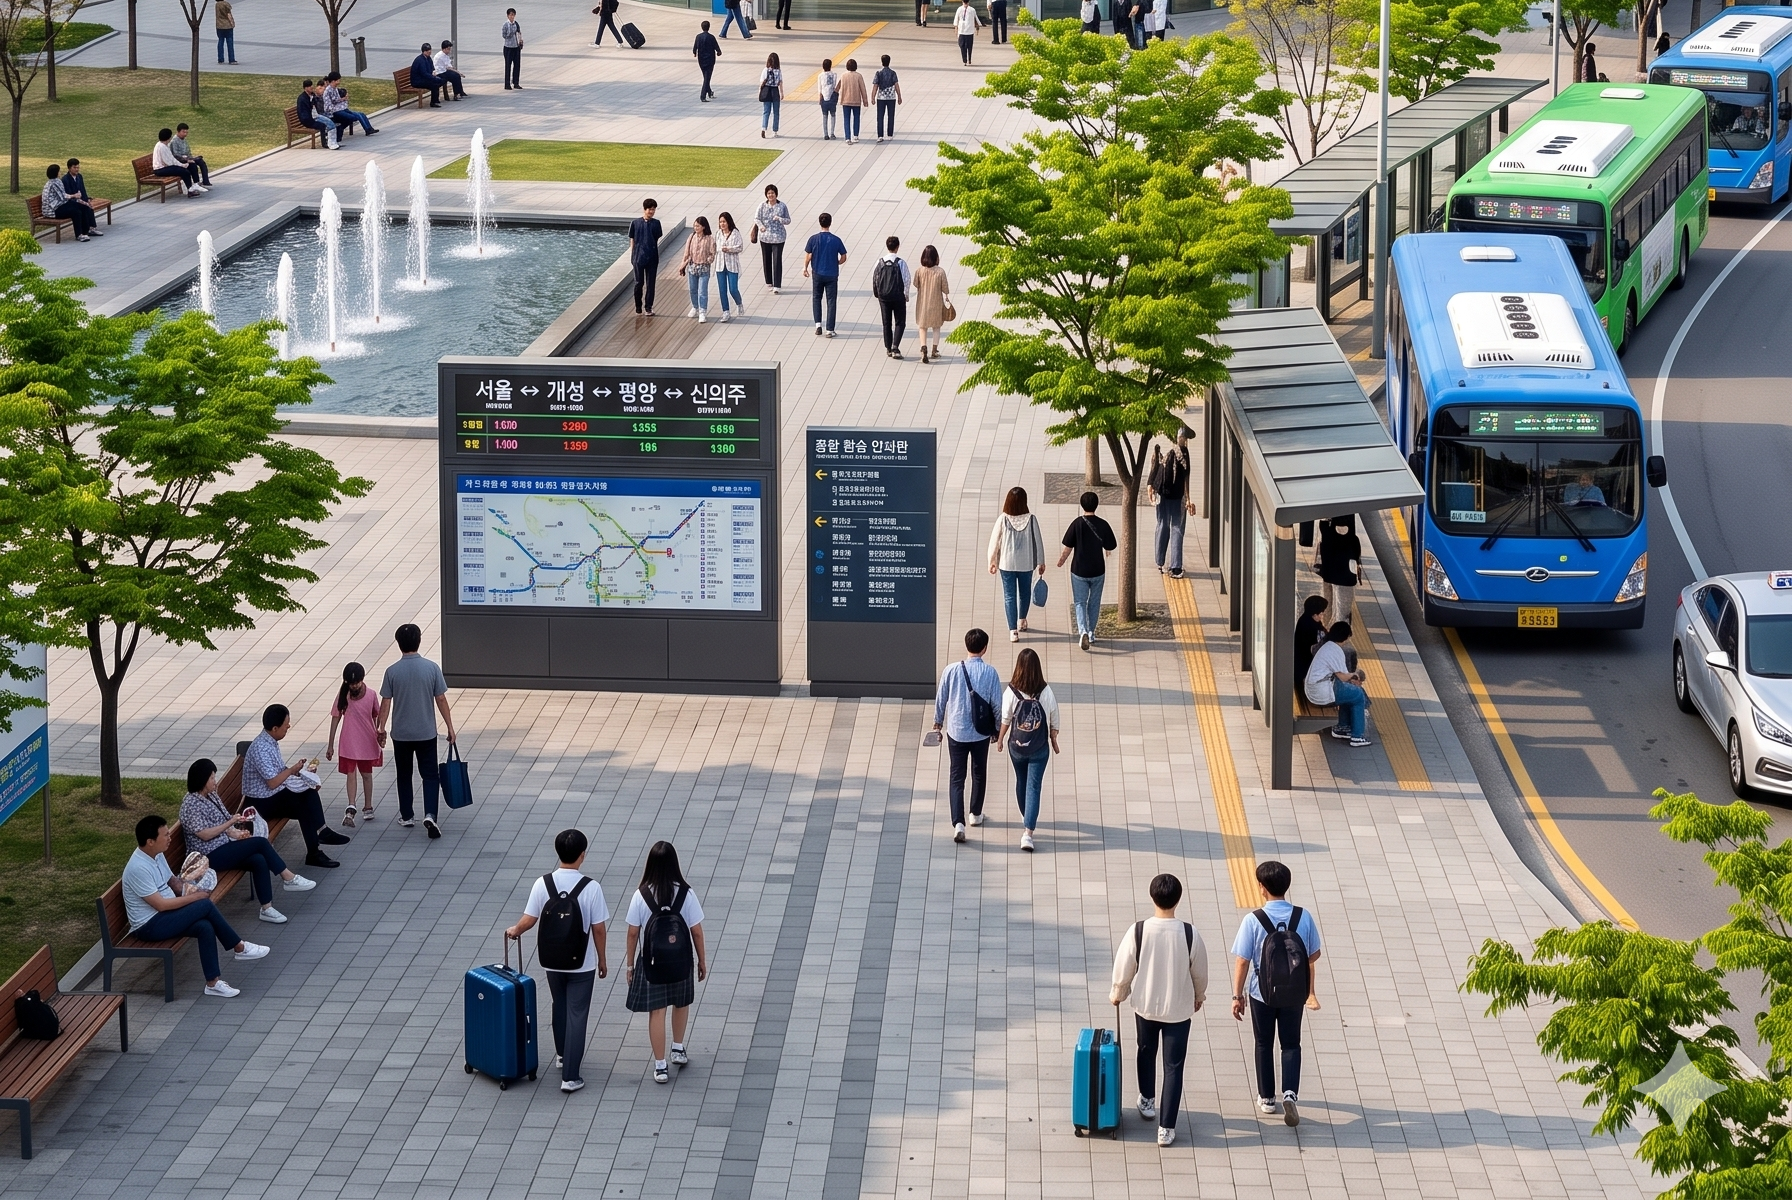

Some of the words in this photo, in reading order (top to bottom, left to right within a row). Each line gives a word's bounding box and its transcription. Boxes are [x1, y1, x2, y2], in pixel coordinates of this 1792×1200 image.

[475, 379, 513, 401] 서울
[547, 380, 584, 402] 개성
[618, 382, 658, 404] 평양
[690, 383, 747, 406] 신의주
